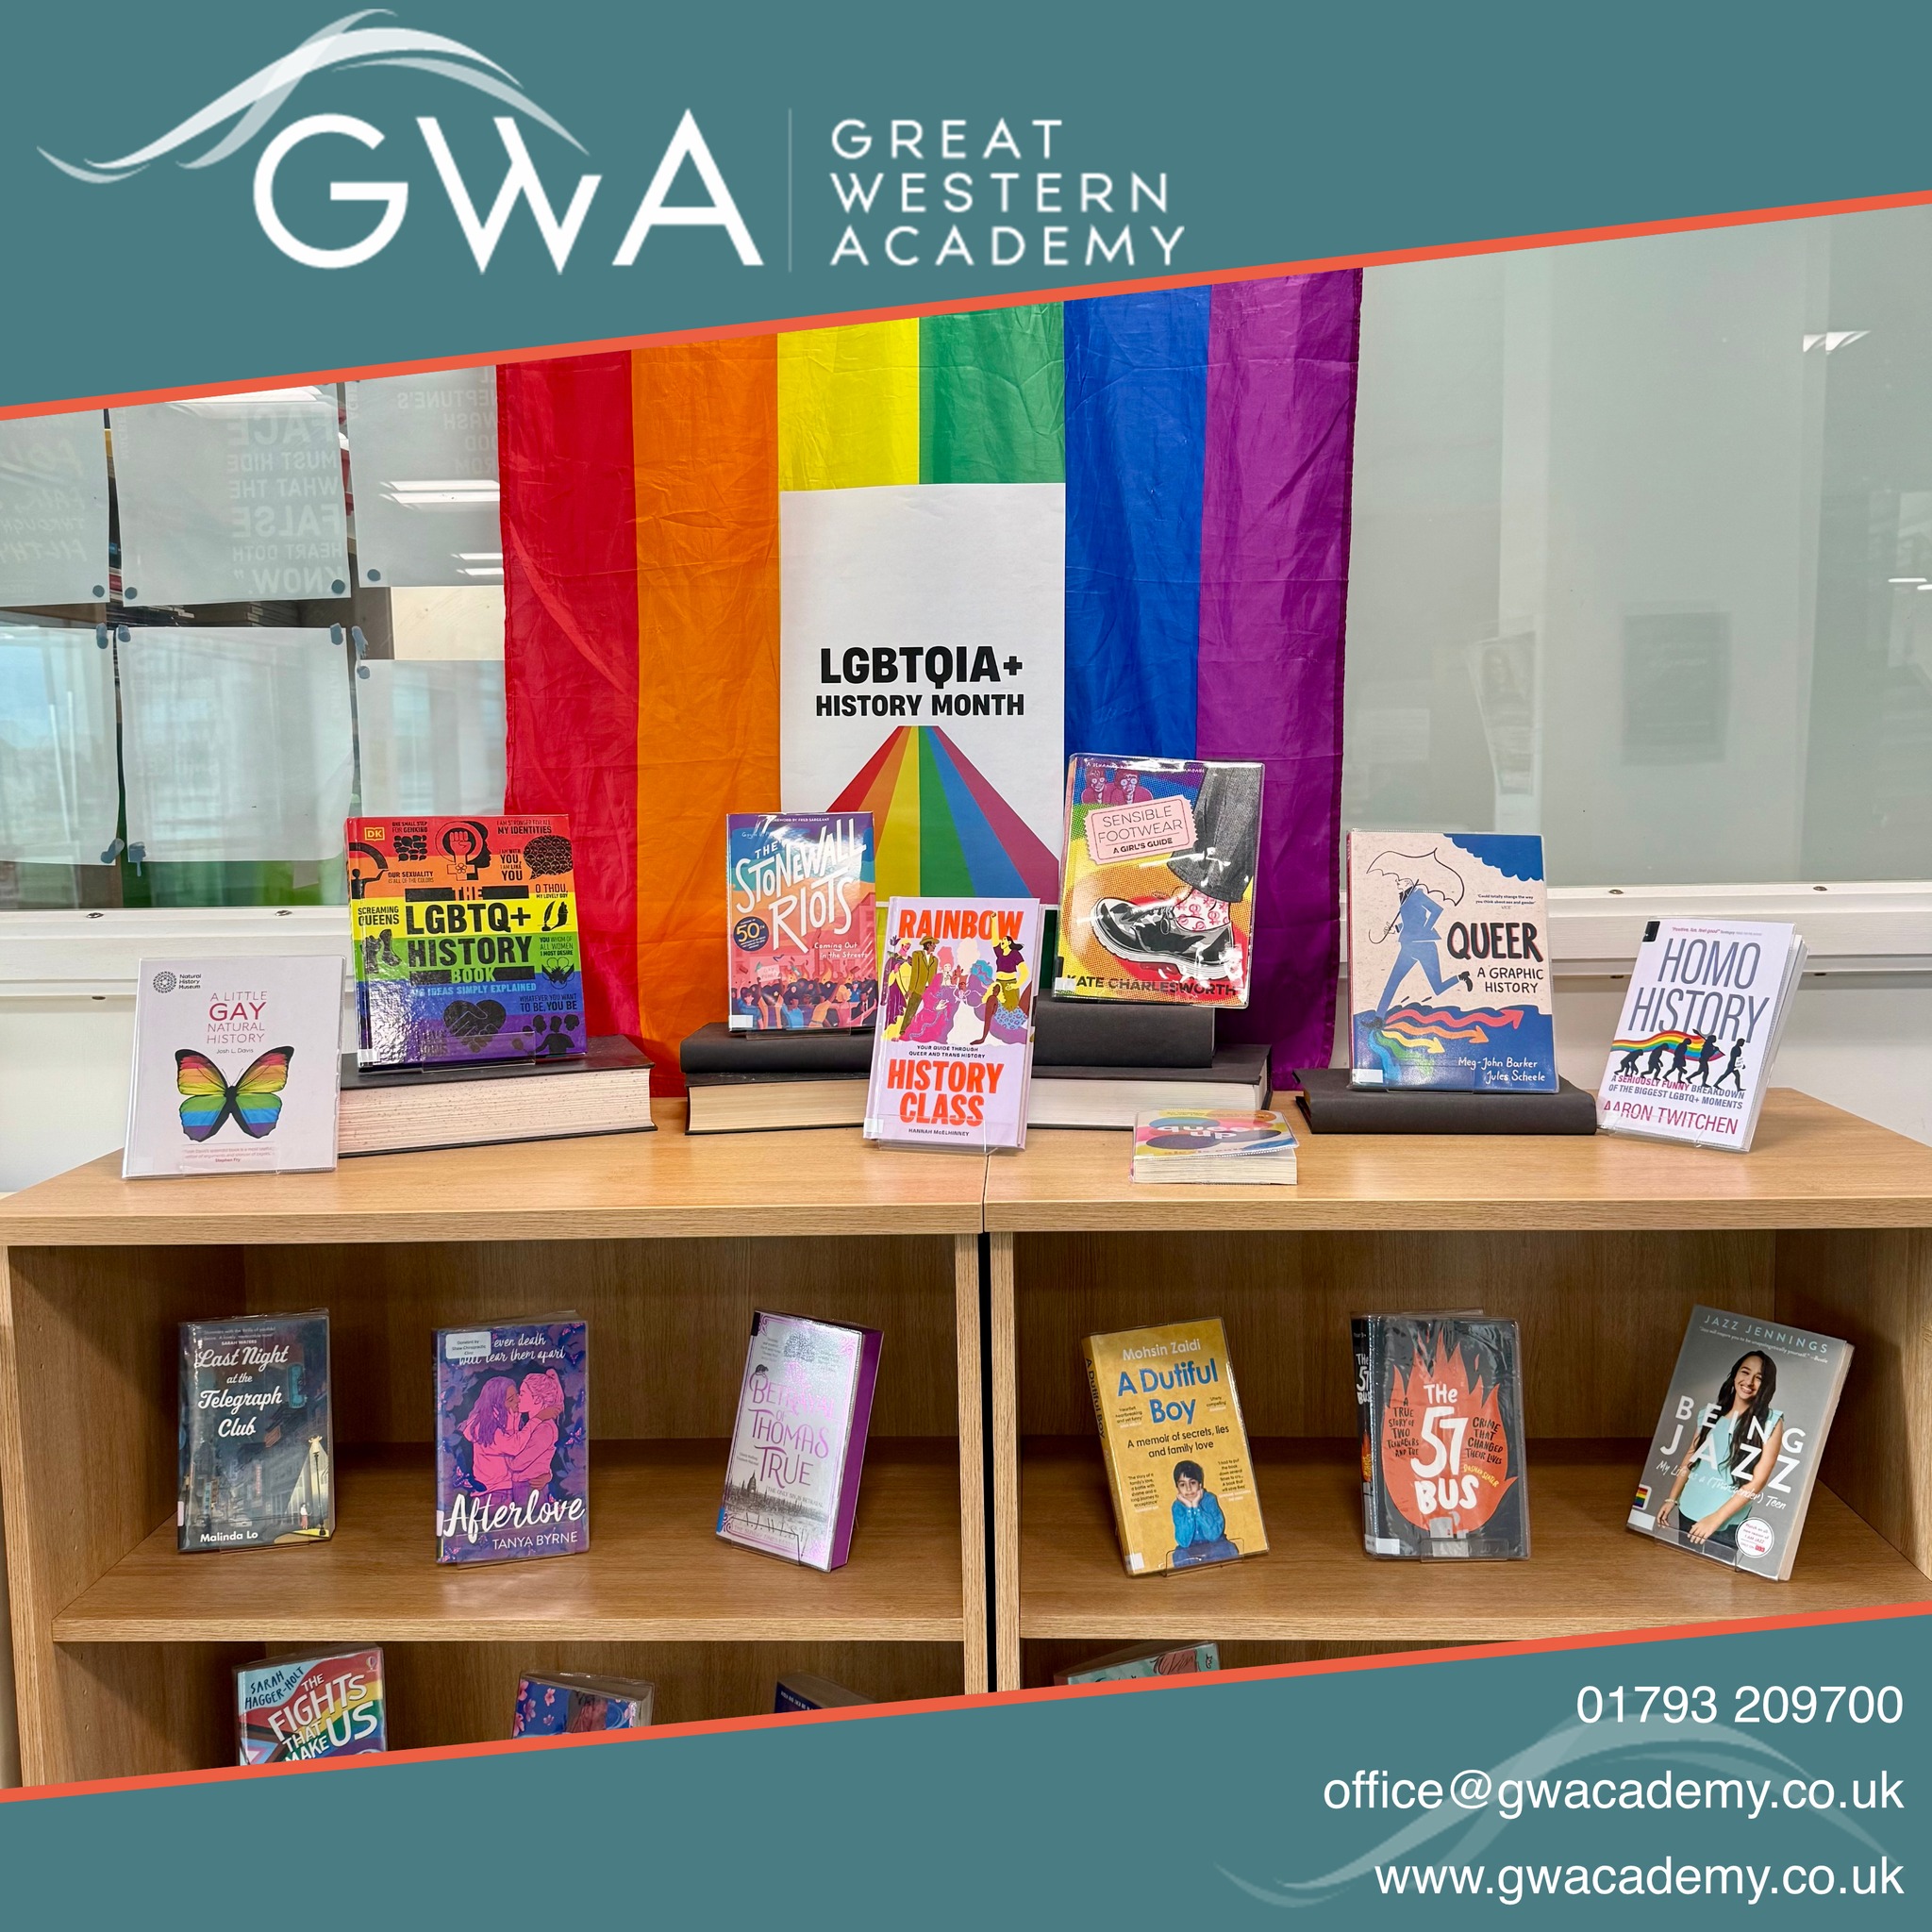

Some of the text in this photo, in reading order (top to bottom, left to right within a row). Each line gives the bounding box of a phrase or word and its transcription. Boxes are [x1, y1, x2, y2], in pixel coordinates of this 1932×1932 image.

[821, 645, 1024, 690] LGBTQIA+
[815, 693, 1024, 717] HISTORY MONTH
[1103, 806, 1173, 827] SENSIBLE
[367, 829, 383, 839] DK
[511, 826, 552, 835] IDENTITIES
[1098, 820, 1183, 843] FOOTWEAR
[755, 841, 778, 859] THE
[1147, 838, 1173, 848] GUIDE
[502, 870, 523, 881] YOU
[735, 817, 867, 914] STONEWALL
[358, 906, 399, 916] SCREAMING
[358, 914, 400, 925] QUEENS
[405, 902, 531, 936] LGBTQ+
[768, 866, 854, 954] RIOTS
[898, 908, 1024, 941] RAINBOW
[408, 936, 532, 968] HISTORY
[814, 941, 842, 952] Coming
[1446, 921, 1543, 962] QUEER
[841, 951, 869, 959] Streets
[1657, 938, 1761, 990] HOMO
[451, 967, 496, 984] BOOK
[1477, 967, 1544, 980] A GRAPHIC
[209, 991, 268, 1001] A LITTLE
[428, 982, 537, 996] IDEAS SIMPLY EXPLAINED
[1108, 977, 1236, 996] CHARLESWORTH
[1485, 981, 1539, 993] HISTORY
[208, 1002, 266, 1022] GAY
[1627, 987, 1771, 1043] HISTORY
[206, 1033, 265, 1044] HISTORY
[207, 1022, 265, 1032] NATURAL
[1457, 1057, 1538, 1070] Meg-John Barker
[887, 1059, 1005, 1094] HISTORY
[1485, 1070, 1546, 1084] Jules Scheele
[1617, 1074, 1660, 1087] SERIOUSLY
[1661, 1079, 1690, 1091] FUNNY
[1690, 1085, 1745, 1100] BREAKDOWN
[1608, 1084, 1743, 1109] OF THE BIGGEST LGBTQ+ MOMENTS
[899, 1091, 985, 1127] CLASS
[1604, 1099, 1739, 1135] AARON TWITCHEN
[493, 1331, 546, 1348] even death
[1704, 1314, 1828, 1355] JAZZ JENNINGS
[197, 1345, 290, 1372] Last Night
[510, 1348, 536, 1361] them
[537, 1345, 566, 1363] apart
[1123, 1338, 1201, 1361] Mohsin Zaidi
[226, 1372, 253, 1384] at the
[1117, 1357, 1219, 1397] A Dutiful
[198, 1386, 282, 1414] Telegraph
[1149, 1398, 1196, 1424] Boy
[1393, 1407, 1414, 1418] TRUE
[218, 1417, 257, 1438] Club
[748, 1408, 829, 1458] THOMAS
[1391, 1427, 1410, 1440] TWO
[1472, 1417, 1501, 1432] CRIME
[1474, 1429, 1497, 1441] THAT
[1675, 1395, 1807, 1454] BEING
[1127, 1424, 1230, 1449] A memoir of secrets, lies
[1410, 1406, 1469, 1478] 57
[1468, 1438, 1504, 1454] CHANGED
[1148, 1439, 1214, 1458] and family love
[1659, 1424, 1801, 1493] JAZZ
[754, 1445, 815, 1489] TRUE
[1414, 1474, 1479, 1515] BUS
[1656, 1459, 1671, 1475] My
[1767, 1495, 1787, 1510] Teen
[443, 1489, 586, 1543] Afterlove
[200, 1531, 258, 1542] Malinda Lo
[491, 1531, 578, 1550] TANYA BYRNE
[244, 1666, 305, 1710] HAGGER-HOLT
[250, 1671, 285, 1695] SARAH
[301, 1673, 325, 1692] THE
[268, 1672, 368, 1742] FIGHTS
[325, 1701, 378, 1747] US
[282, 1721, 323, 1753] THAT
